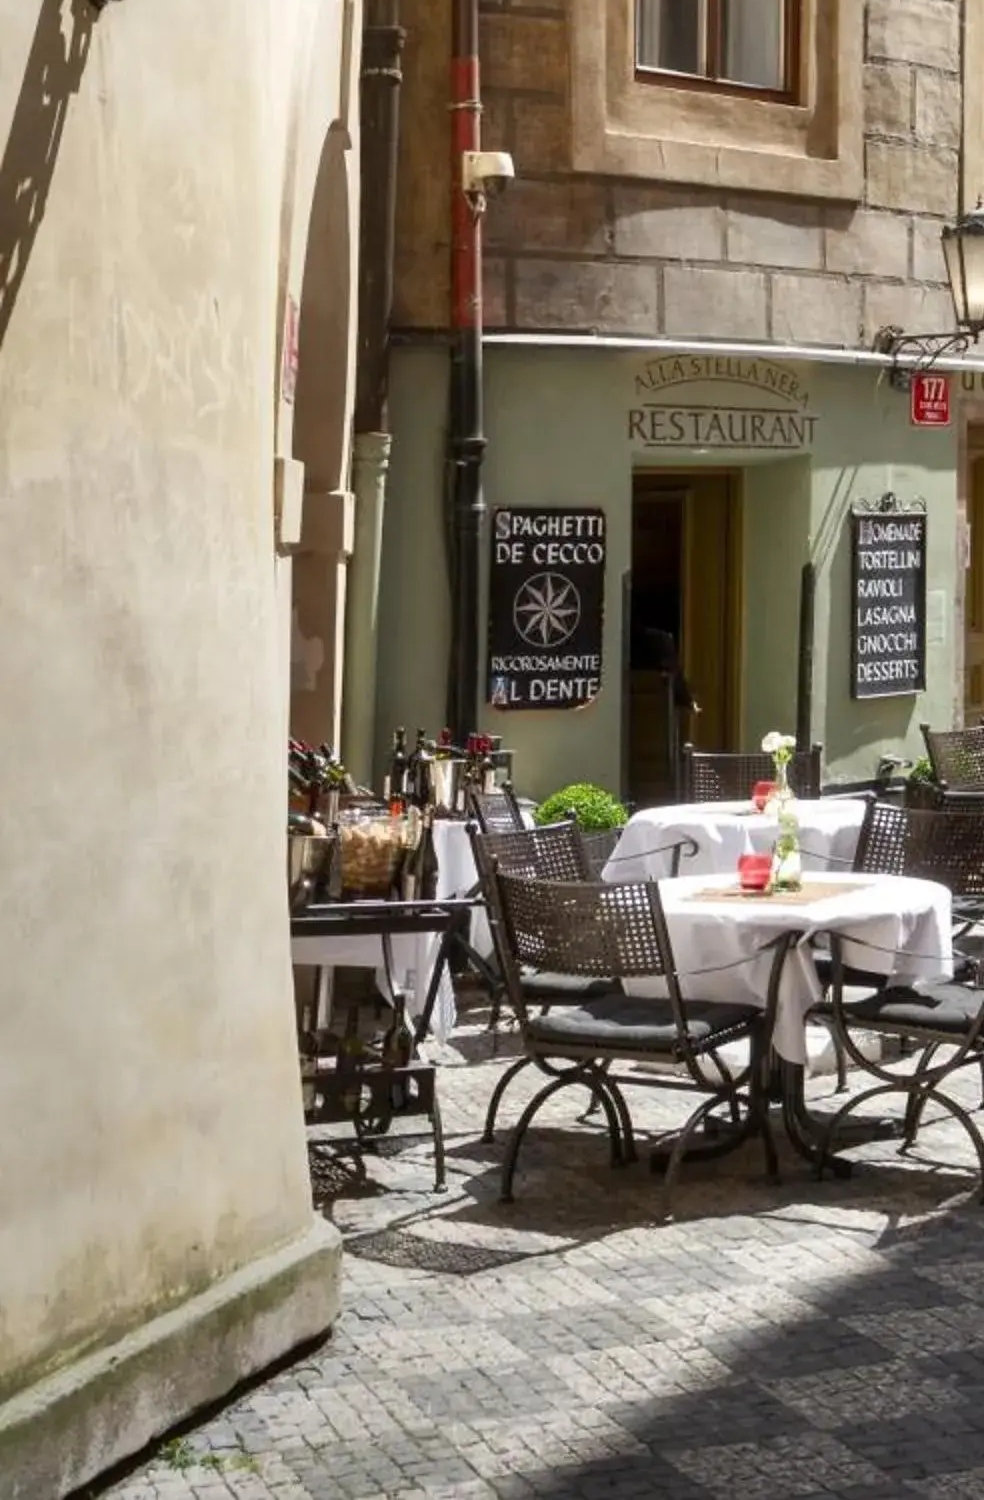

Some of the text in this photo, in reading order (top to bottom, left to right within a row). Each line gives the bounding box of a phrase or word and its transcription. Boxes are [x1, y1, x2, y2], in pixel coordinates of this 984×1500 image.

[635, 356, 809, 409] ALLA STELLA NERA
[921, 378, 945, 400] 177
[628, 408, 819, 445] RESTAURANT
[496, 511, 602, 539] SPAGHETTI
[497, 542, 603, 565] DE CECCO
[858, 550, 921, 570] TORTELLINI
[857, 578, 903, 598] RAVIOLI
[857, 604, 917, 627] LASAGNA
[857, 631, 918, 655] GNOCCHI
[491, 655, 600, 672] RIGOROSAMENTE
[857, 659, 919, 683] DESSERTS
[492, 677, 599, 705] AL DENTE
